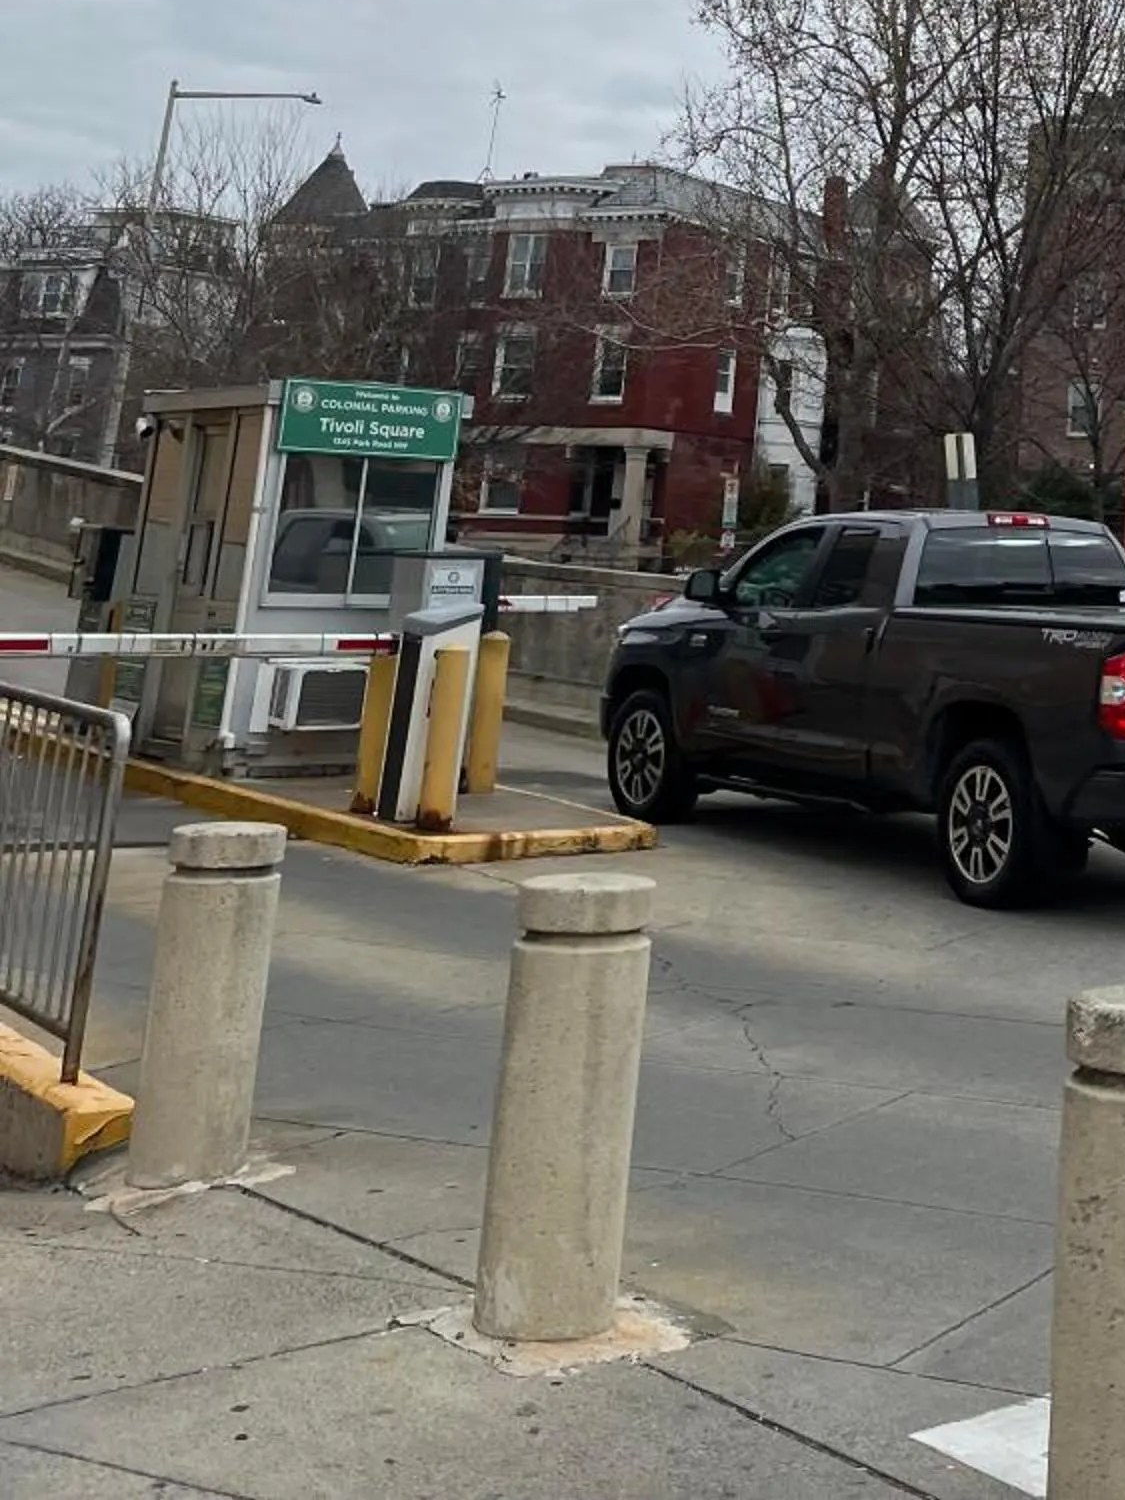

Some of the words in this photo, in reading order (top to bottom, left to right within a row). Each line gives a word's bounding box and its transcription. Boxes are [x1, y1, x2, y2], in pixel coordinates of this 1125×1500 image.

[321, 399, 379, 413] COLONIAL
[381, 403, 429, 417] PARKING
[319, 417, 365, 435] Tivoli
[369, 421, 425, 439] Square
[1041, 627, 1078, 645] TRD
